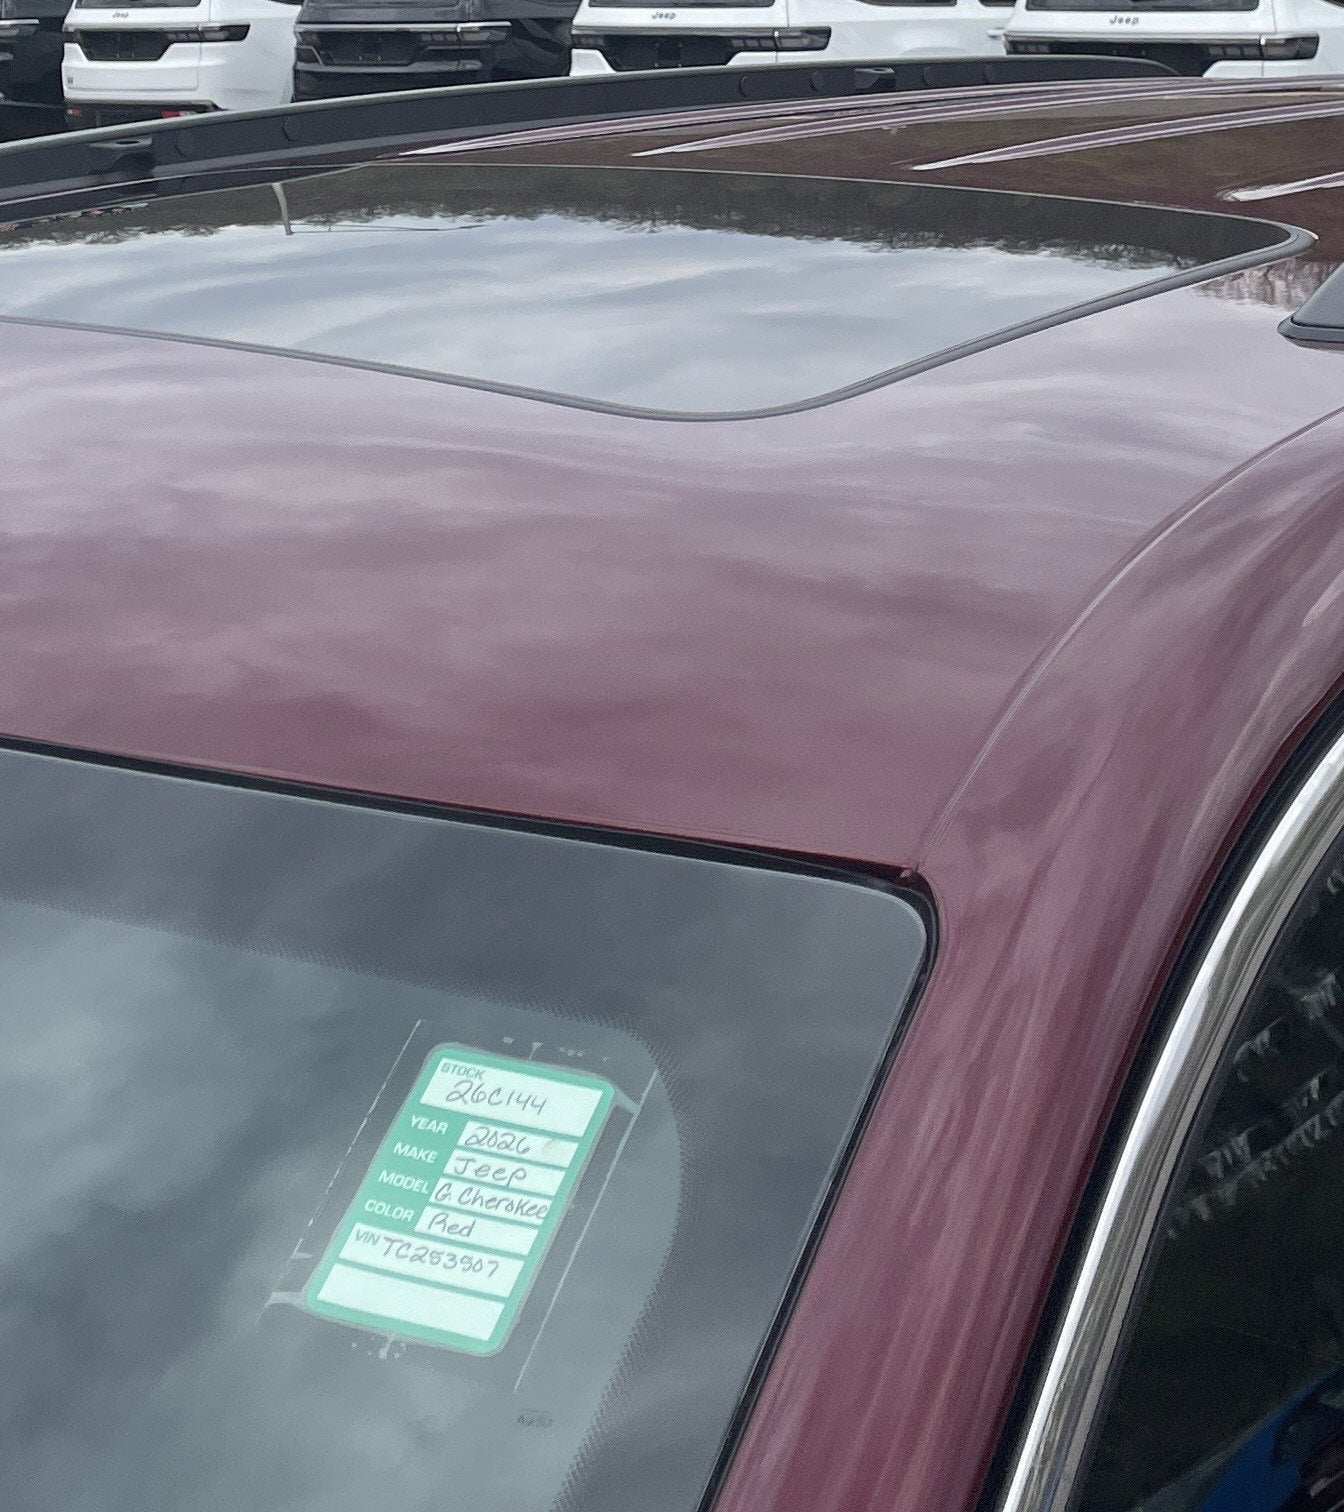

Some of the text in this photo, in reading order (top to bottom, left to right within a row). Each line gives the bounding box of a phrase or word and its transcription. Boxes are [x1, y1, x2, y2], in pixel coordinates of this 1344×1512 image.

[441, 1062, 486, 1080] STOCK
[446, 1079, 547, 1115] 26C144
[411, 1115, 448, 1135] YEAR
[393, 1141, 439, 1164] MAKE
[465, 1126, 531, 1155] 2026
[378, 1170, 430, 1195] MODEL
[453, 1156, 527, 1189] Jeep
[364, 1199, 415, 1223] COLOR
[457, 1187, 549, 1220] Cherokee
[354, 1228, 381, 1246] VIN
[427, 1212, 477, 1238] Red
